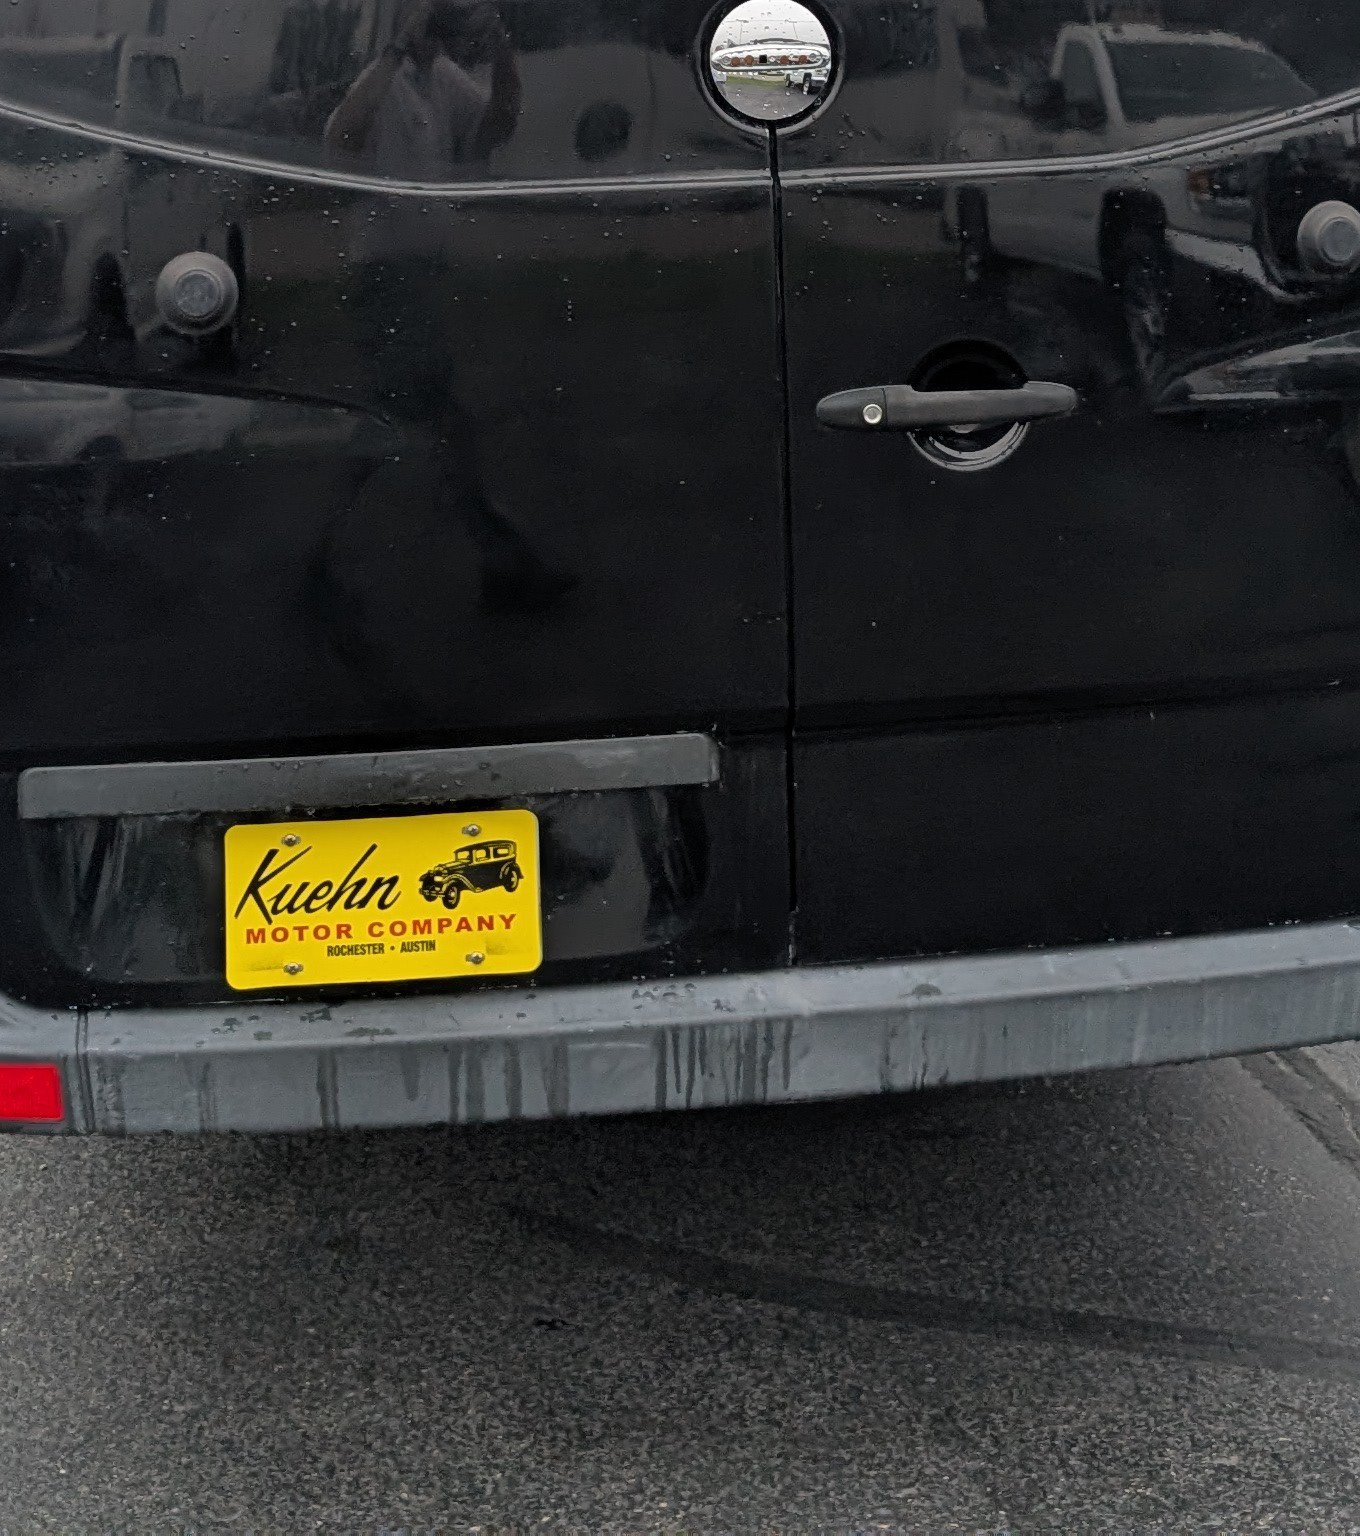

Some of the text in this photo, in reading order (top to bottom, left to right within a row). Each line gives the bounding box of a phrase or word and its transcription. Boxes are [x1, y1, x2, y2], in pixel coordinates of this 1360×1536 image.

[234, 843, 402, 925] Kuehn
[245, 914, 517, 944] MOTOR COMPANY
[327, 940, 437, 957] ROCHESTER AUSTIN
